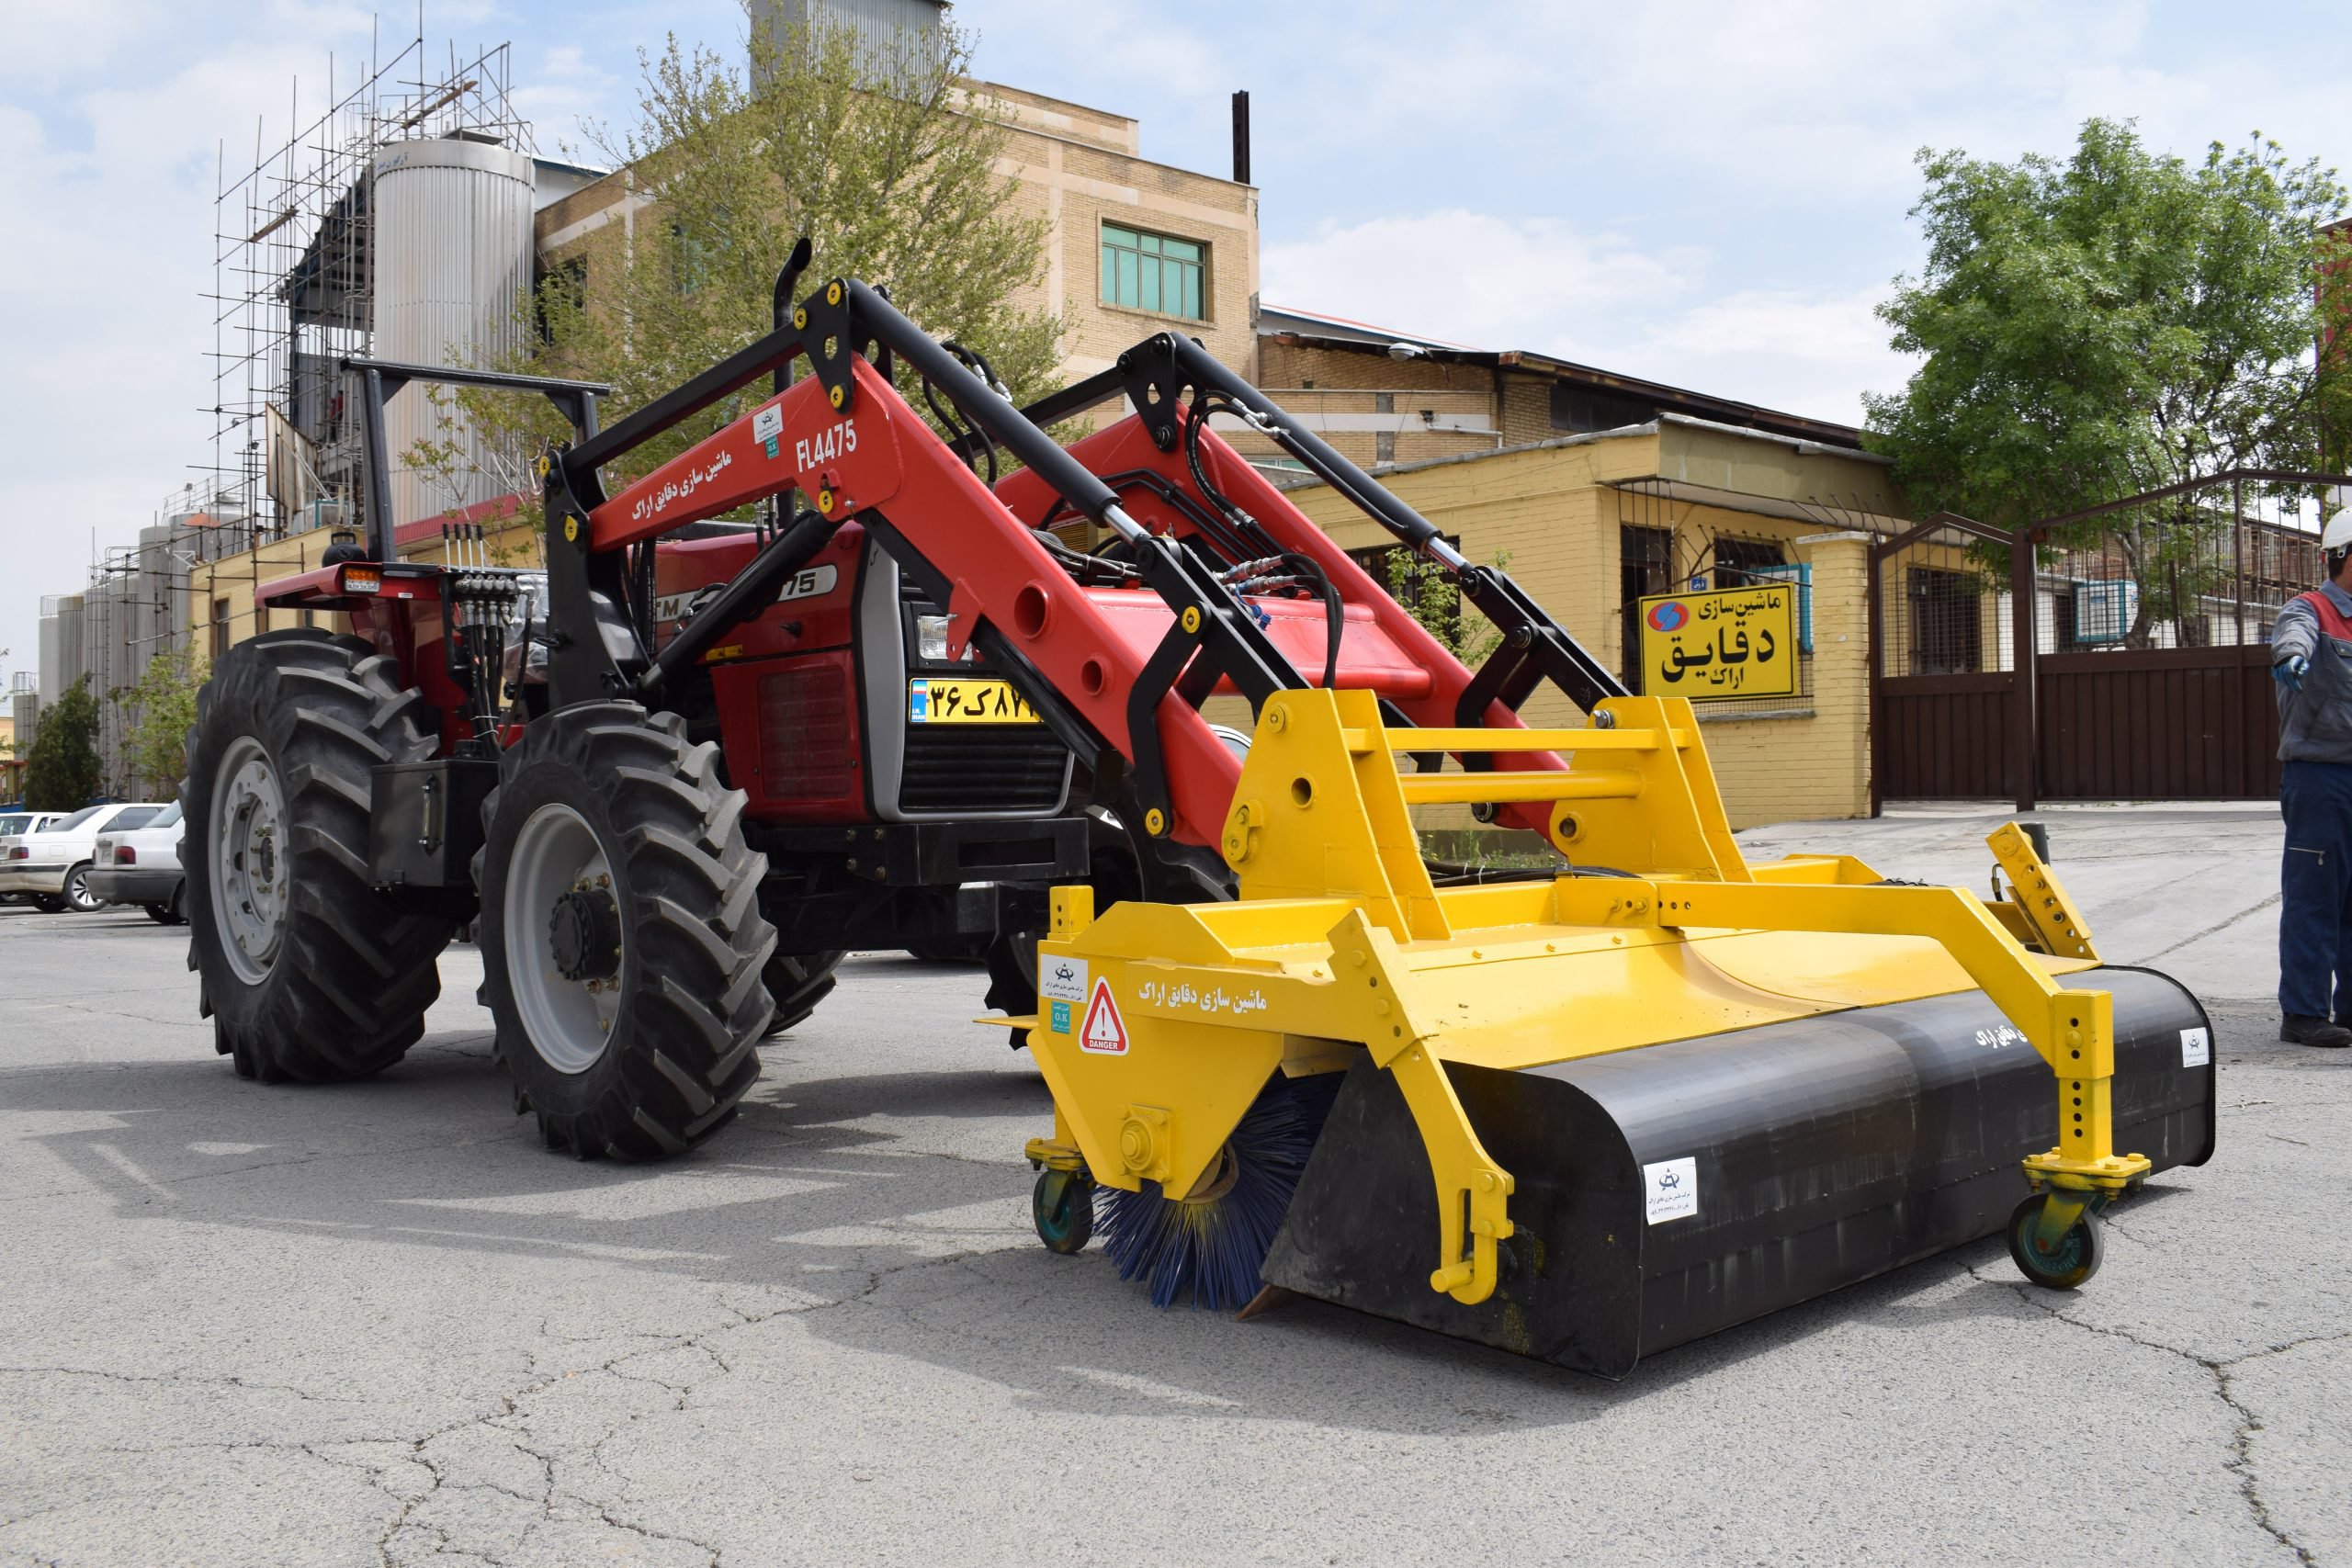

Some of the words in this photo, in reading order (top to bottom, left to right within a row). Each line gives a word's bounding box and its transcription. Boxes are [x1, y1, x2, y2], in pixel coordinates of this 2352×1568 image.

[796, 418, 857, 473] FL4475
[705, 449, 732, 482] ماشین
[680, 467, 704, 498] سازی
[632, 494, 653, 520] اراک
[655, 482, 678, 513] دقایق
[1699, 597, 1735, 621] سازی
[1736, 592, 1781, 617] ماشین
[1661, 620, 1775, 683] دقایق
[1710, 666, 1745, 690] اراک
[1139, 982, 1165, 1007] اراک
[1168, 983, 1197, 1008] دقایق
[1200, 987, 1230, 1012] سازی
[1233, 989, 1267, 1014] ماشین
[1089, 1039, 1118, 1050] DANGER
